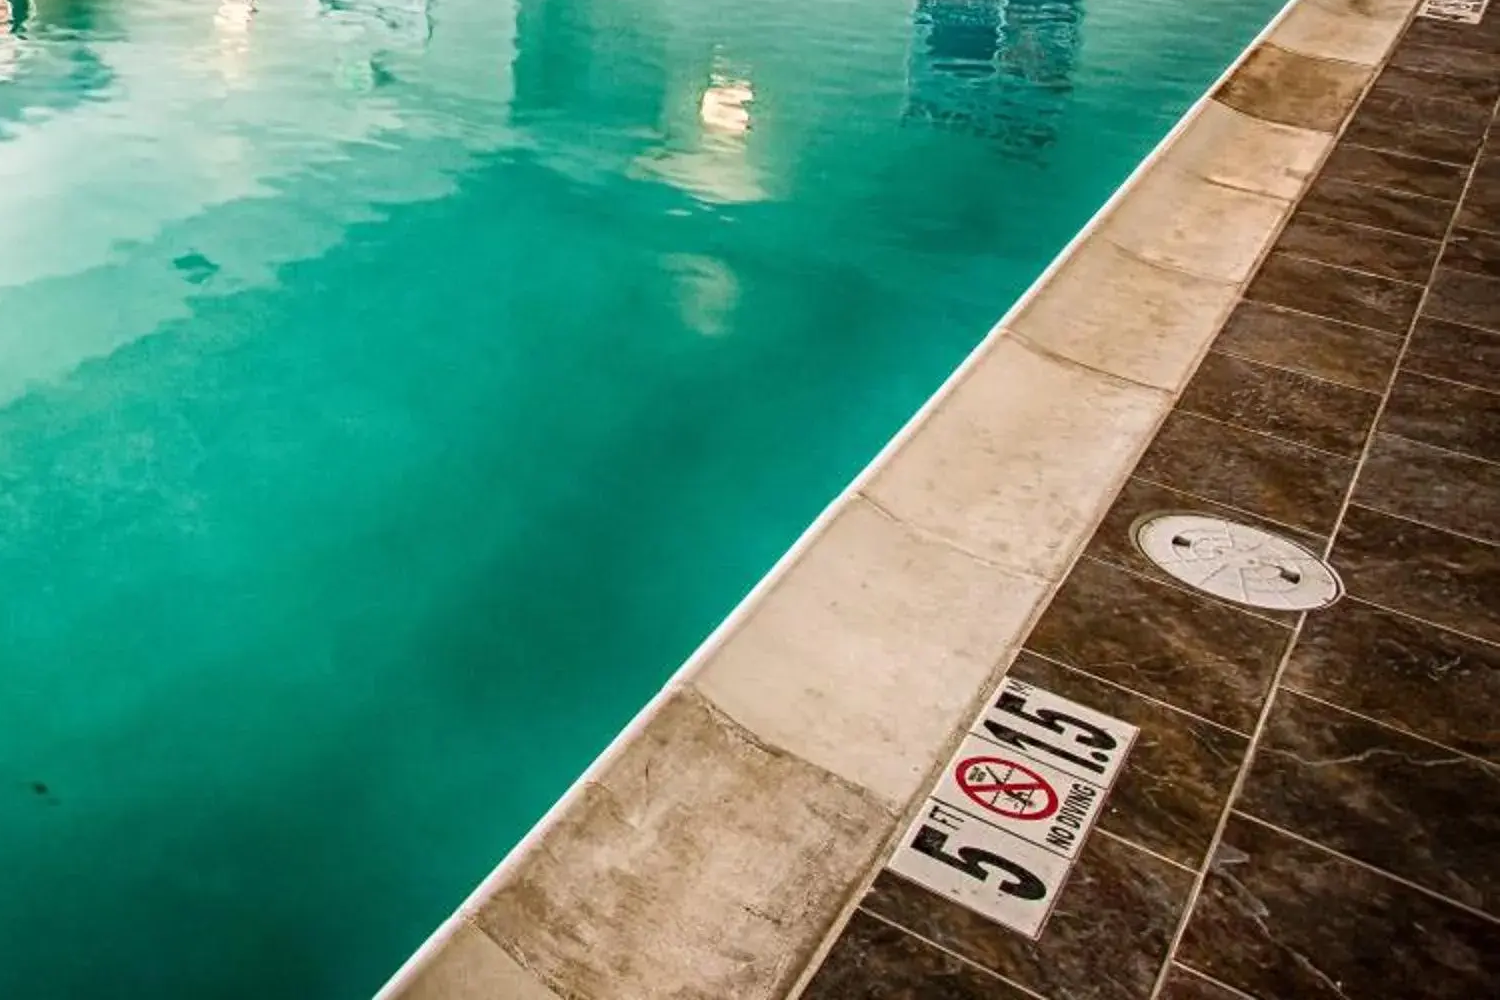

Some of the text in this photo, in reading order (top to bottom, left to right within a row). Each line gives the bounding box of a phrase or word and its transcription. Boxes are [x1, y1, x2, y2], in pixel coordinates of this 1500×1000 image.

[984, 692, 1117, 775] 1.5
[910, 806, 1047, 900] 5 FT
[1046, 783, 1097, 851] NO DIVING
